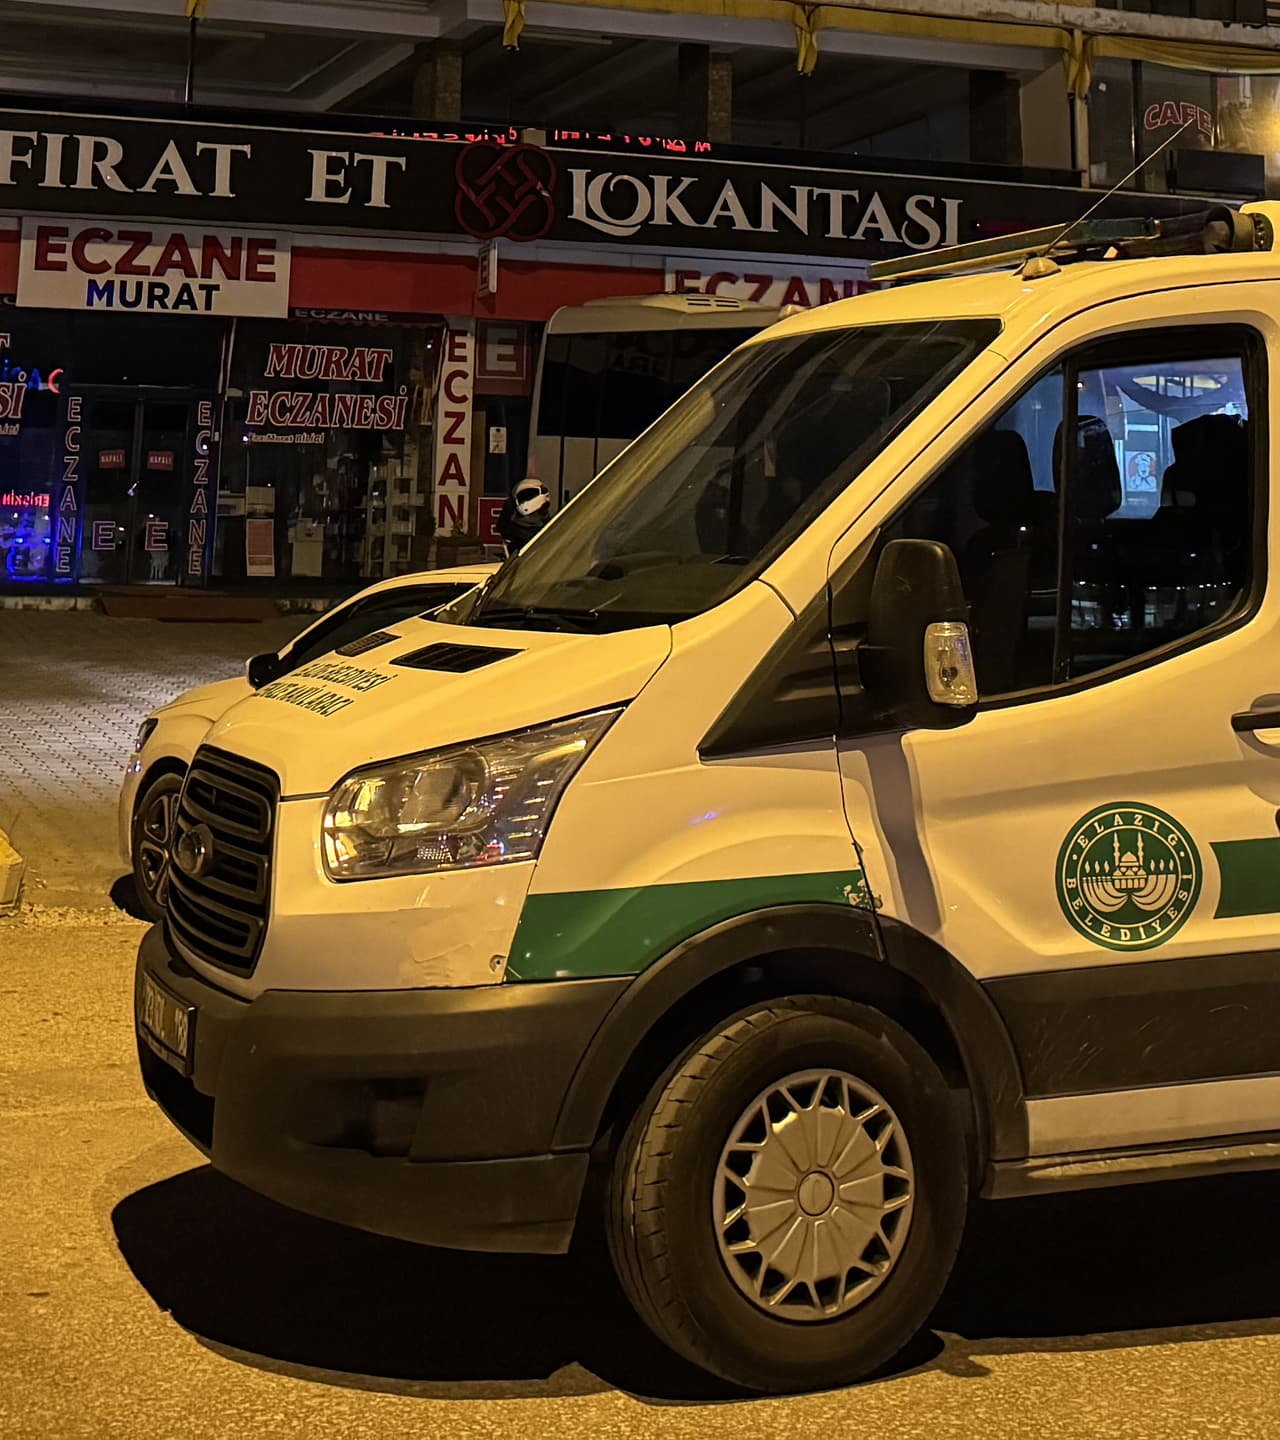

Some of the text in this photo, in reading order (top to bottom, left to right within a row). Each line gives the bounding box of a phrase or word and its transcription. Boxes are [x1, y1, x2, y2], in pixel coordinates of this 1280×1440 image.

[1143, 100, 1213, 137] CAFE
[304, 148, 407, 209] ET
[566, 168, 964, 251] LOKANTASI
[33, 224, 277, 284] ECZANE
[85, 278, 221, 313] MURAT
[264, 343, 394, 382] MURAT
[245, 385, 409, 430] ECZANESİ
[56, 396, 83, 573] ECZANE
[187, 401, 213, 576] ECZANE
[91, 520, 117, 551] E
[144, 521, 169, 551] E
